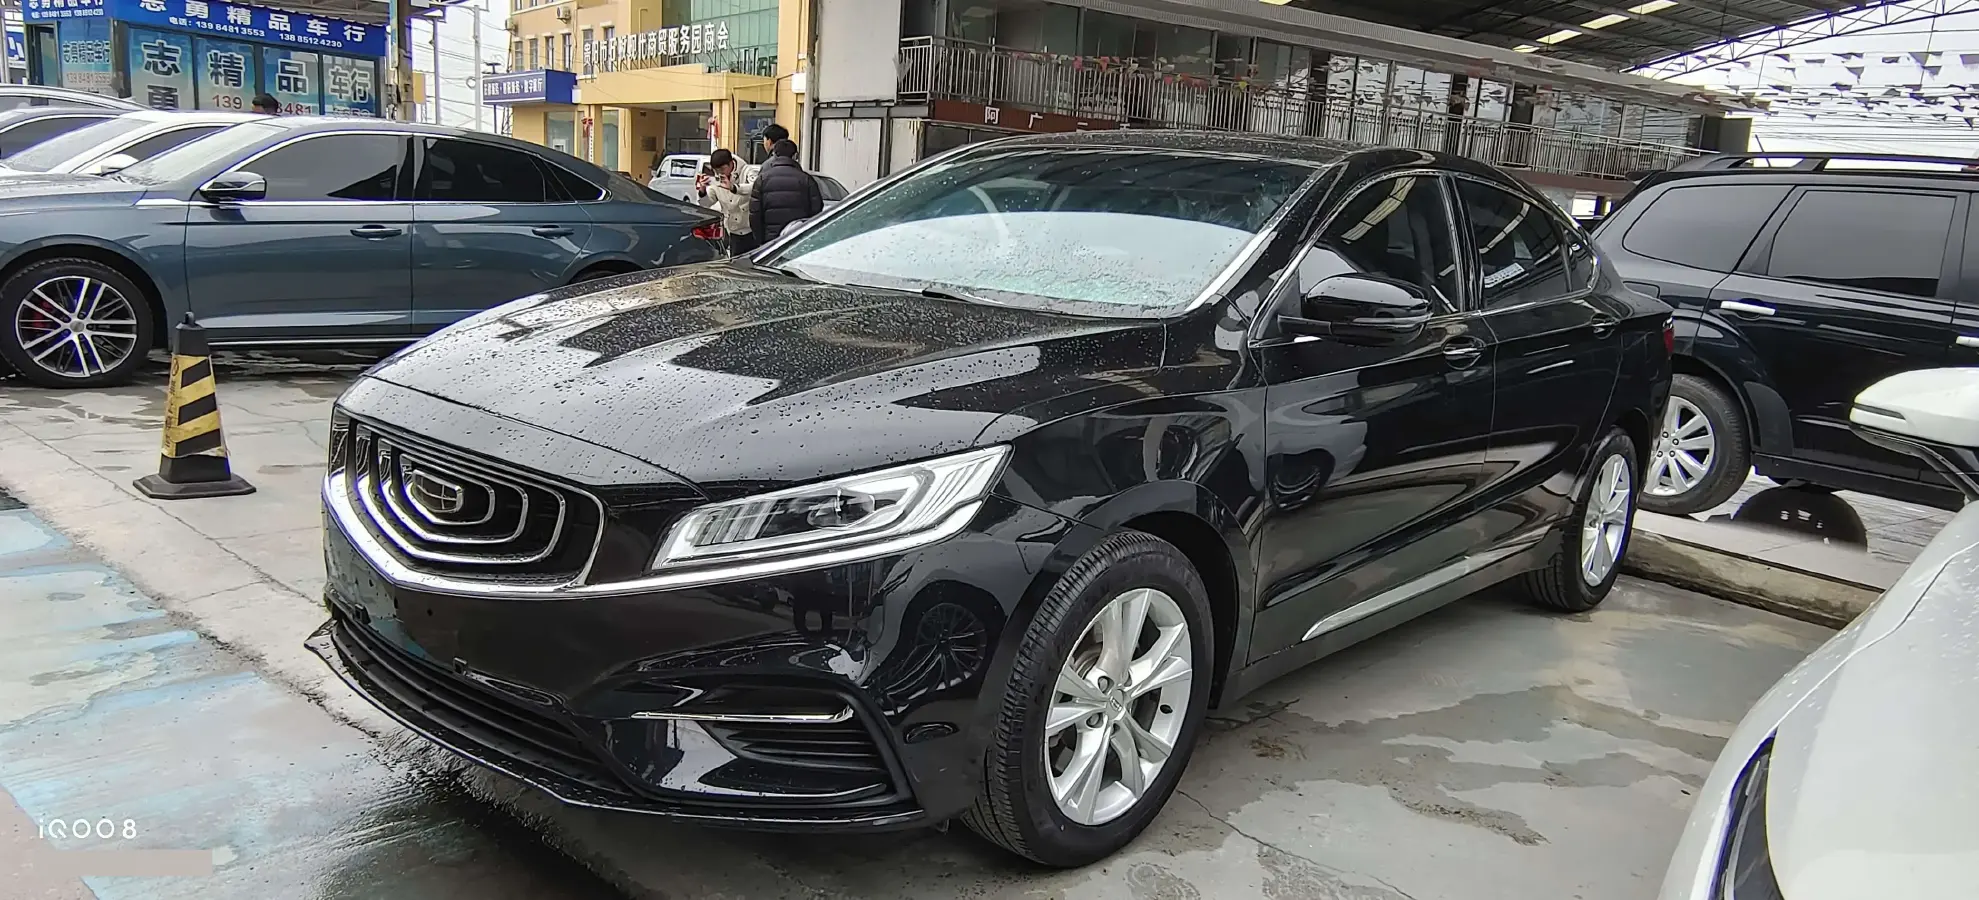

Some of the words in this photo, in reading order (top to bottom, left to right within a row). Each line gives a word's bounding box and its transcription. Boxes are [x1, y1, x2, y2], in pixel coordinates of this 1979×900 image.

[195, 21, 213, 30] 139
[279, 33, 296, 41] 138
[63, 40, 111, 64] 志勇精品车行
[212, 95, 242, 110] 139
